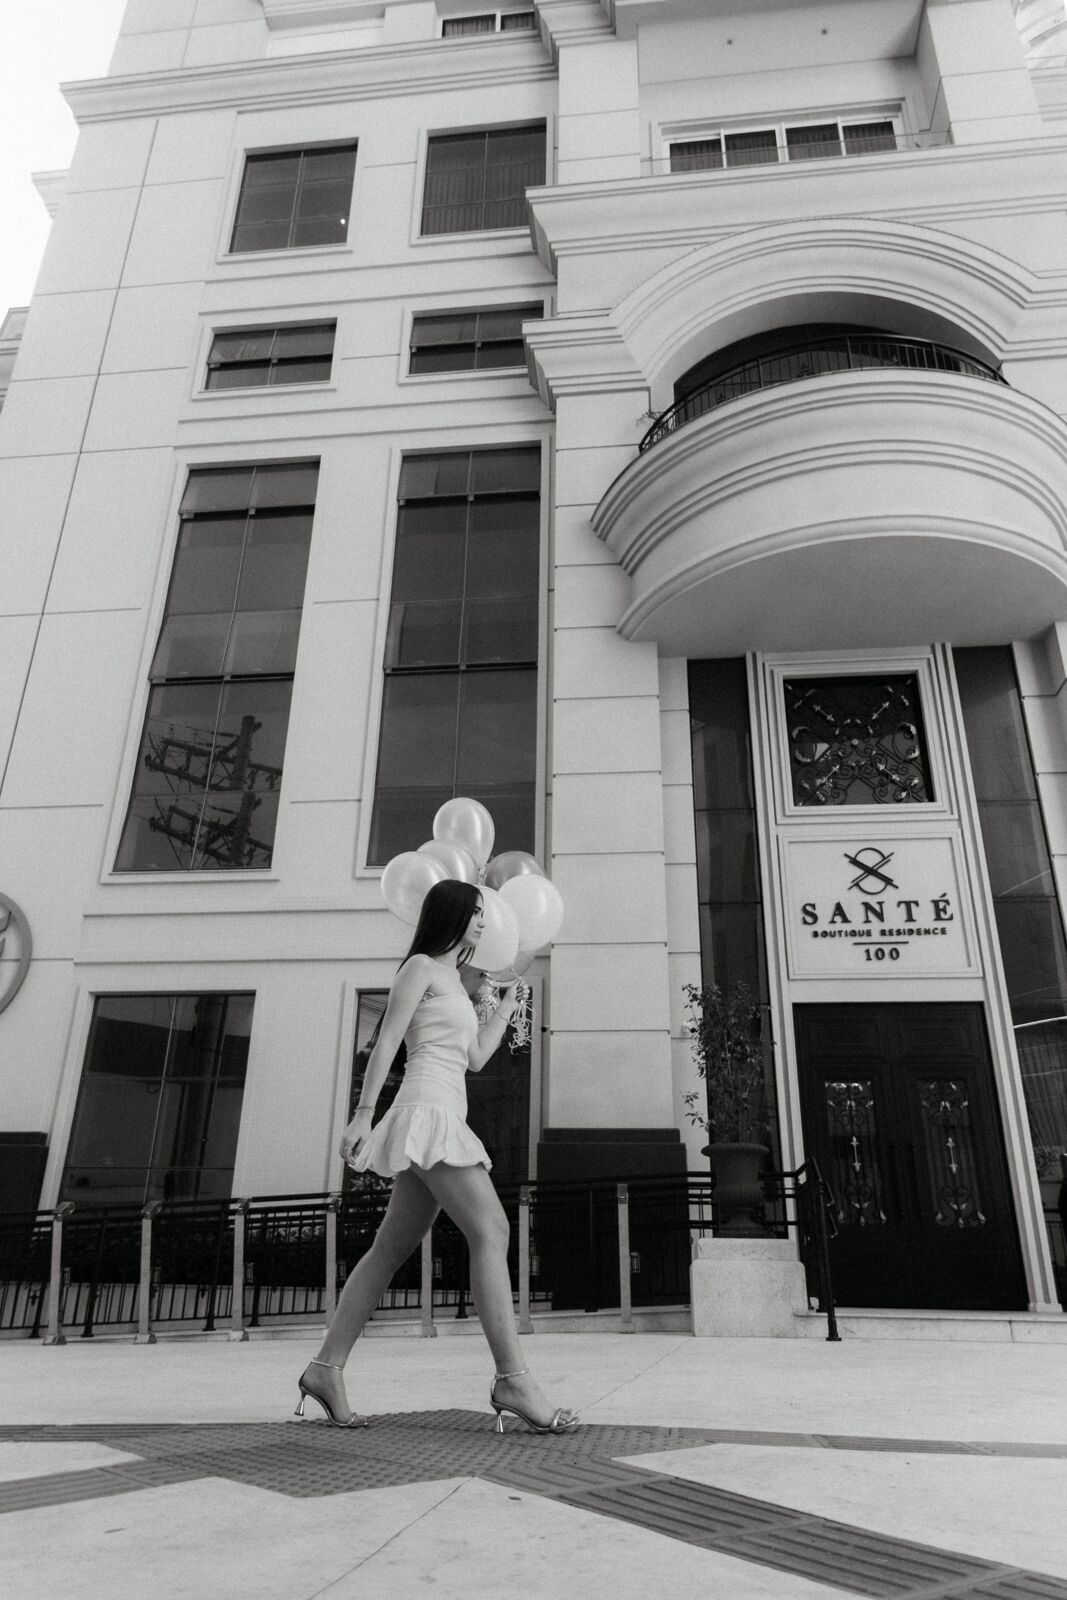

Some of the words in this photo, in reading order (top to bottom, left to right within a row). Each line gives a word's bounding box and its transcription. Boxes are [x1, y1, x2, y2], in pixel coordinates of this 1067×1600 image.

[802, 893, 954, 925] SANTÉ
[812, 929, 873, 939] BOUTIQUE
[880, 927, 948, 937] RESIDENCE
[865, 947, 900, 961] 100
